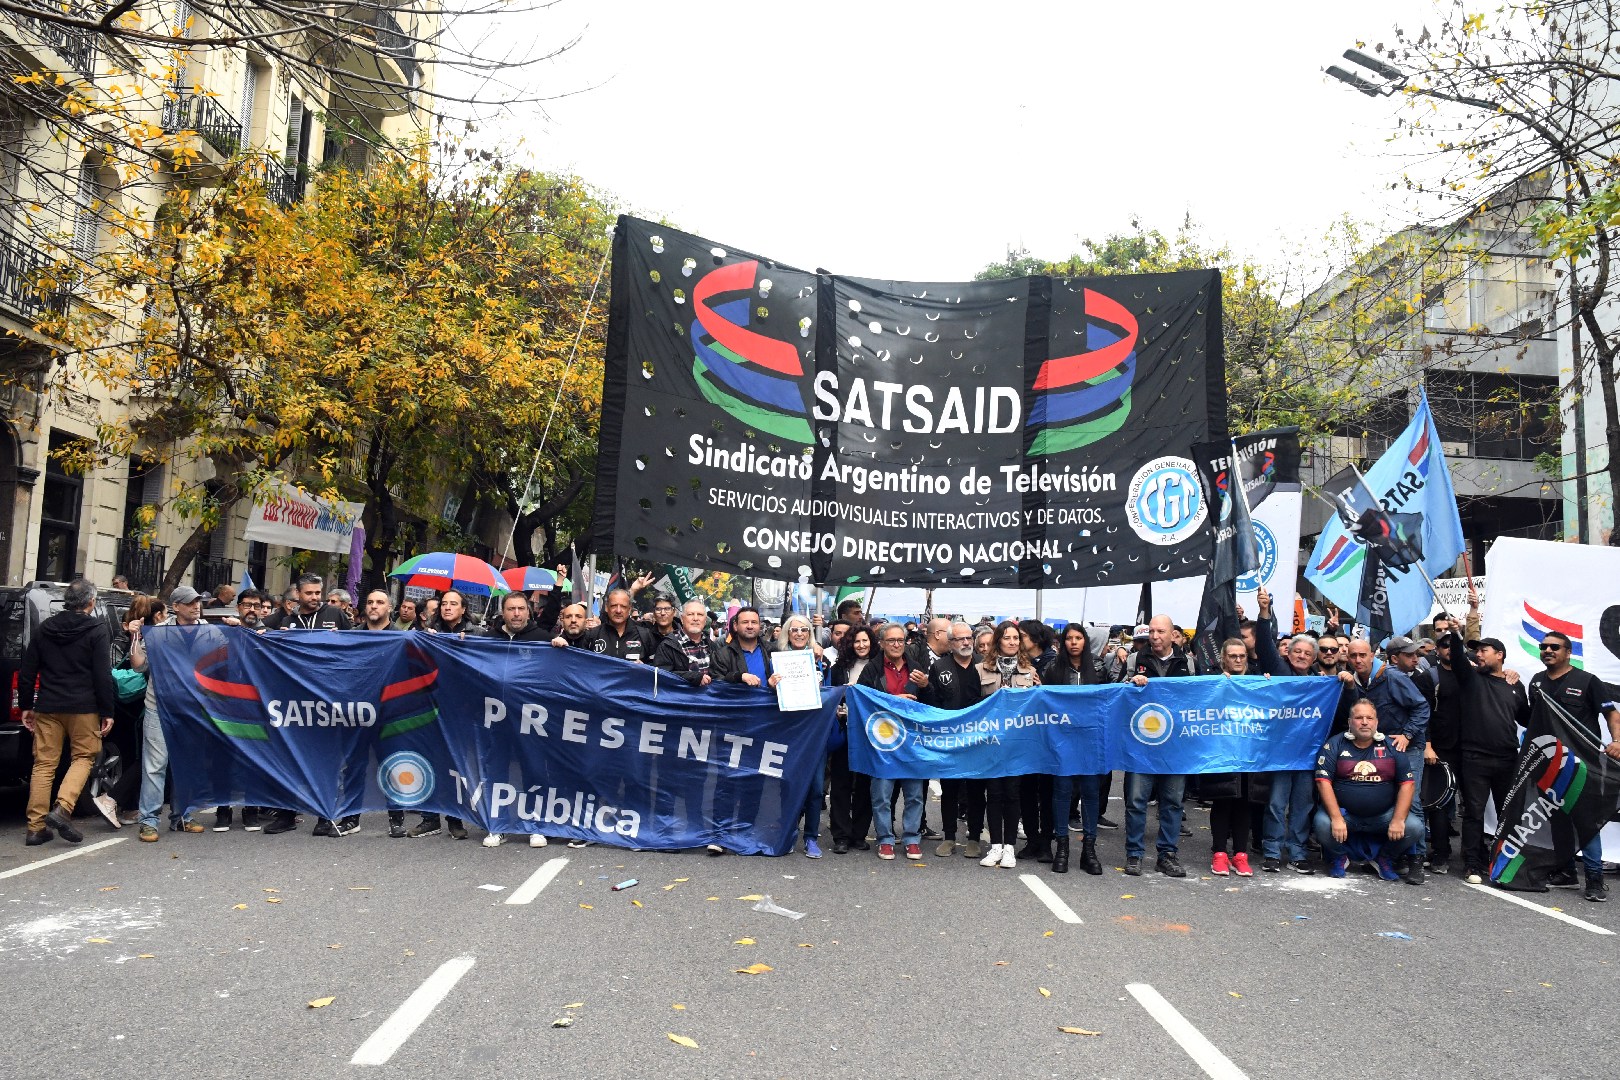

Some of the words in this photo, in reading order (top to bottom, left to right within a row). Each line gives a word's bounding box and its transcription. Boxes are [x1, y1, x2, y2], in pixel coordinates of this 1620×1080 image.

[812, 370, 1022, 434] SATSAID
[688, 433, 812, 480] Sindicato
[820, 451, 950, 494] Argentino
[960, 467, 991, 495] de
[1000, 464, 1116, 493] Televisión
[1243, 474, 1266, 493] ATSAID
[708, 487, 787, 514] SERVICIOS
[790, 498, 907, 529] AUDIOVISUALES
[912, 510, 1020, 530] INTERACTIVOS
[1024, 510, 1033, 526] Y
[1037, 509, 1054, 525] DE
[1058, 507, 1105, 525] DATOS.
[743, 526, 837, 555] CONSEJO
[842, 536, 953, 564] DIRECTIVO
[959, 540, 1063, 564] NACIONAL
[1254, 553, 1273, 584] TRABAO
[940, 673, 951, 682] TV
[267, 700, 376, 728] SATSAID
[913, 717, 1000, 734] TELEVISIÓN
[1004, 713, 1071, 730] PÚBLICA
[1179, 704, 1265, 722] TELEVISIÓN
[1268, 705, 1322, 720] PÚBLICA
[484, 697, 788, 778] PRESENTE
[913, 734, 1001, 749] ARGENTINA
[1179, 722, 1263, 738] ARGENTINA
[449, 769, 485, 812] TV
[490, 782, 641, 839] Pública
